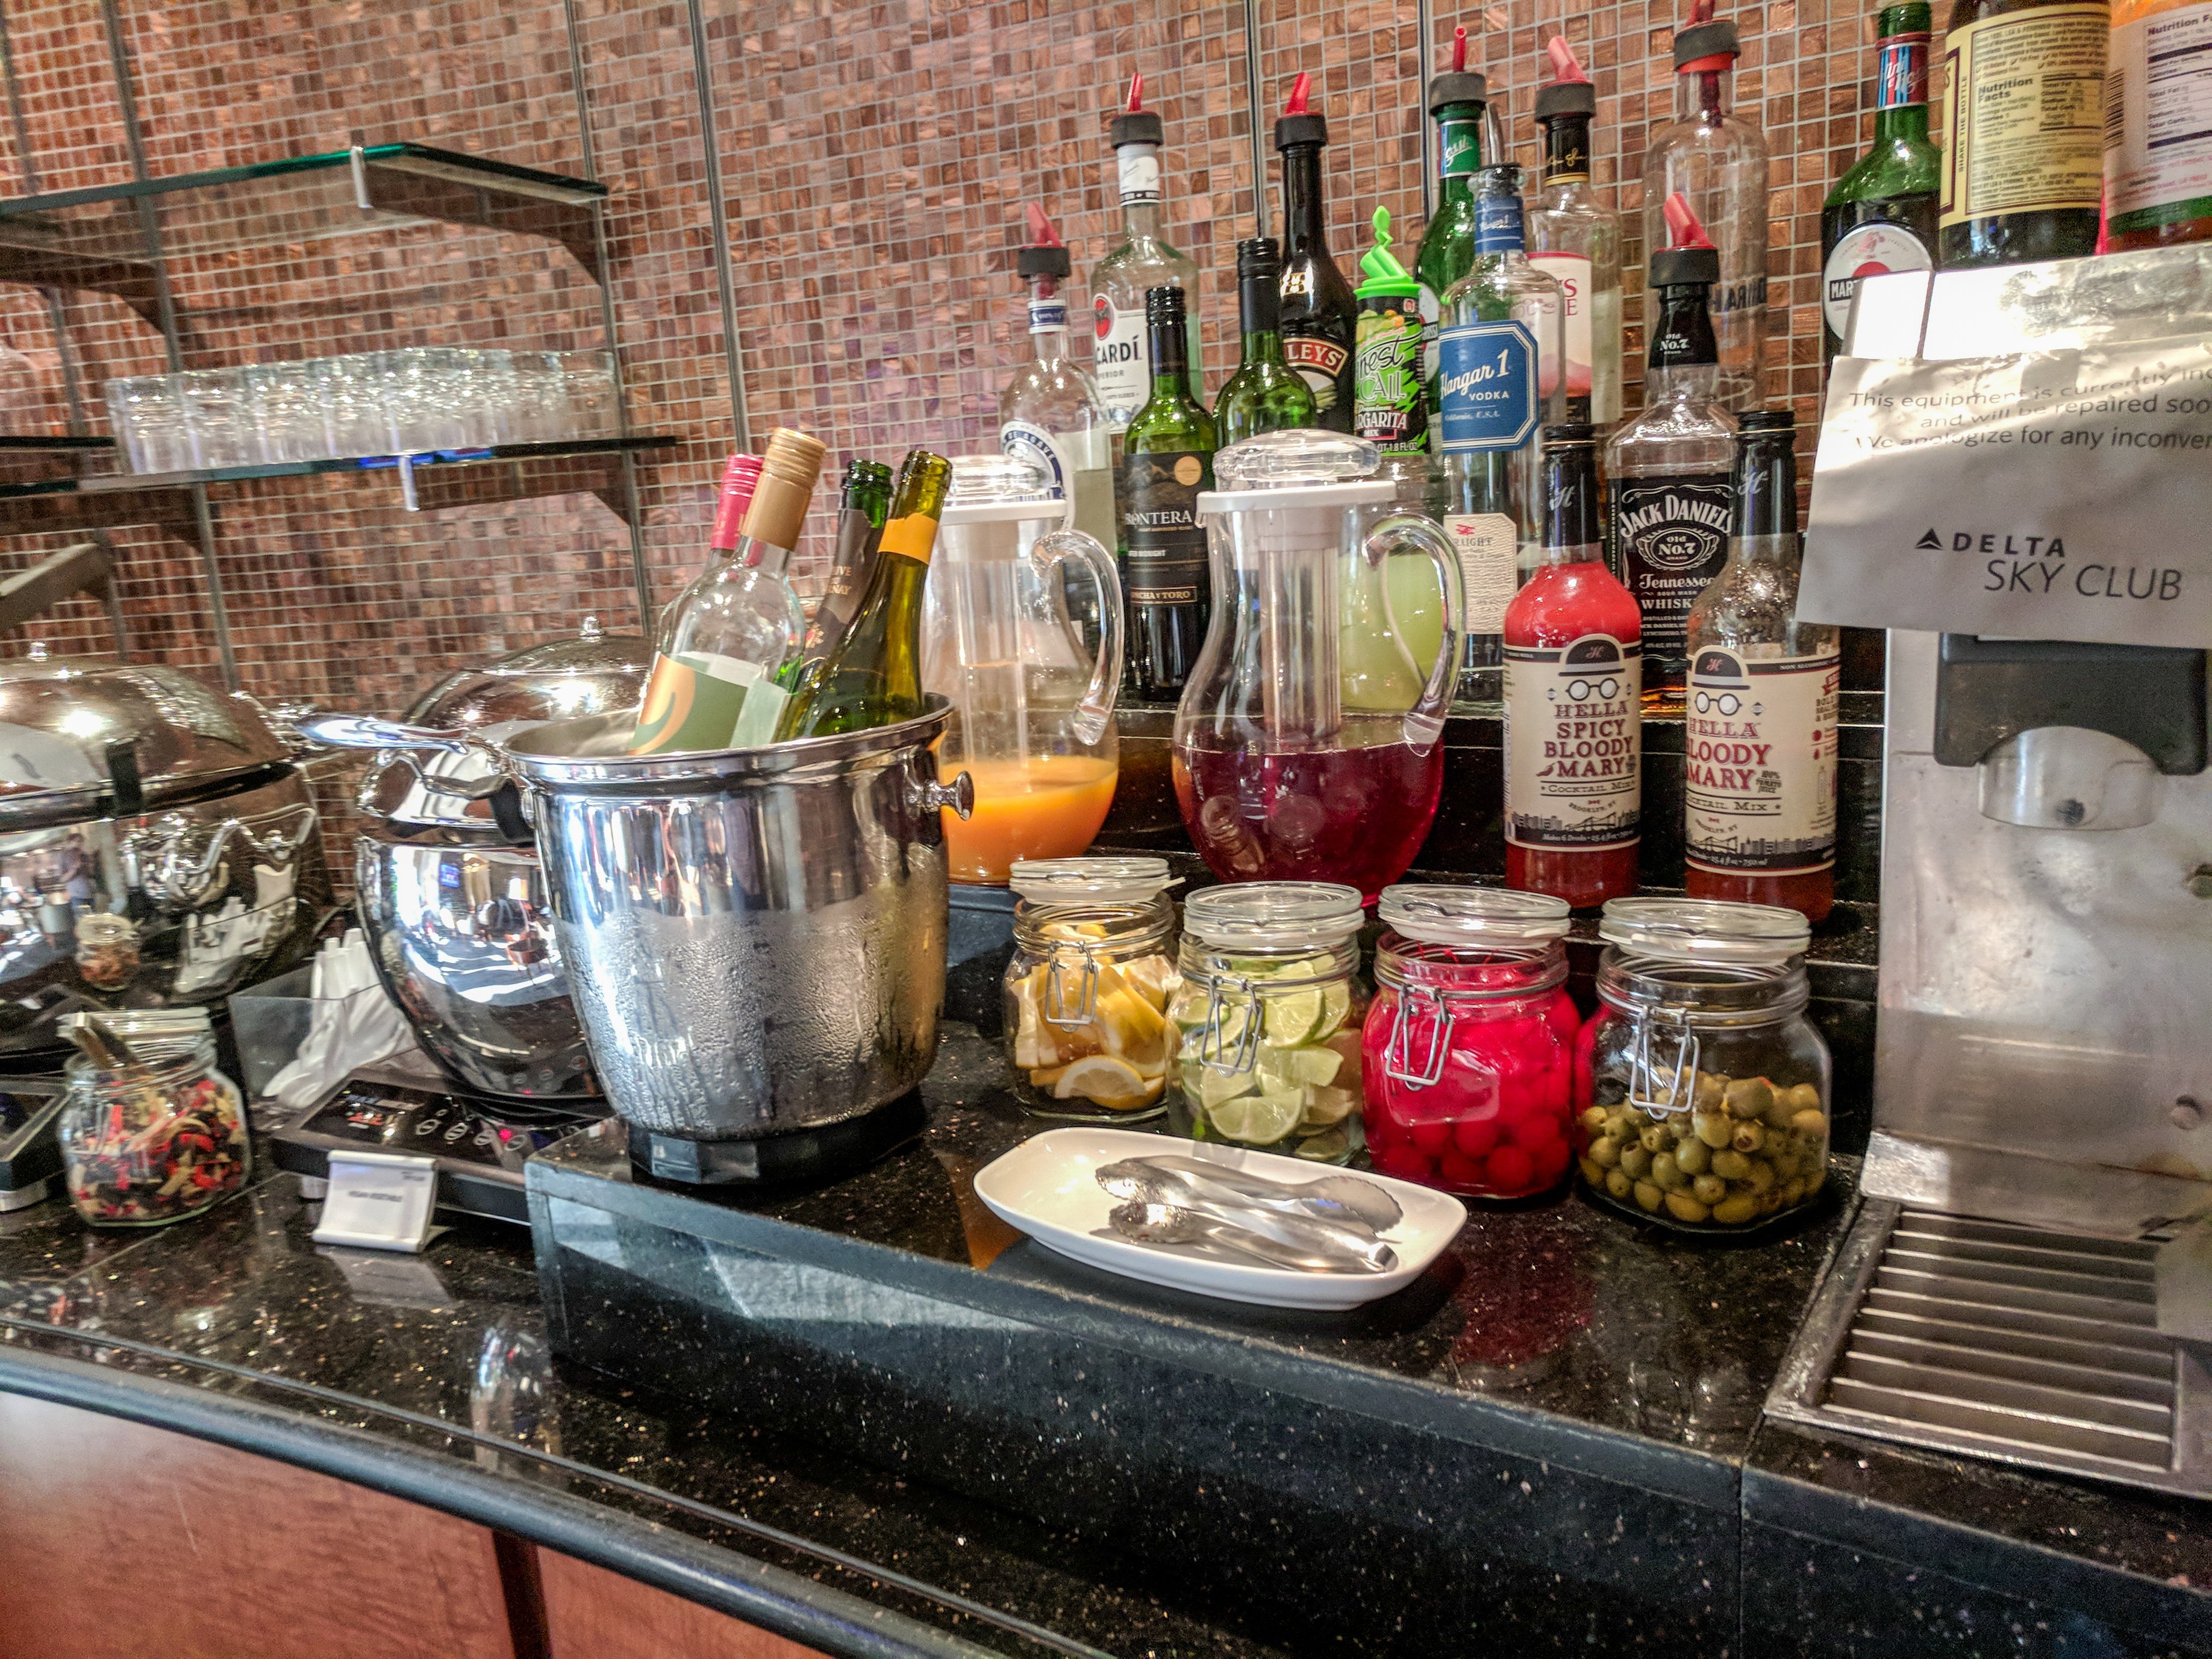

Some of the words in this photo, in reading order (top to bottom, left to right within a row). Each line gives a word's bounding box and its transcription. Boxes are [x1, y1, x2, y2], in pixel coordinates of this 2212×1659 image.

[2148, 18, 2199, 36] Nutrition
[2202, 14, 2212, 22] F
[1978, 77, 2033, 96] Nutrition
[1978, 90, 2011, 104] Facts
[1440, 364, 1495, 400] Hangar
[1496, 349, 1510, 378] 1
[1360, 370, 1407, 402] CALL
[1469, 390, 1510, 401] VODKA
[1849, 393, 1894, 407] This
[1901, 389, 2025, 409] equipment
[2034, 387, 2052, 400] is
[2060, 373, 2172, 396] currently
[1920, 414, 1963, 428] and
[1971, 408, 2011, 423] will
[2055, 393, 2159, 417] repaired
[2164, 398, 2212, 414] soo
[2021, 425, 2055, 445] for
[2060, 428, 2106, 451] any
[1618, 501, 1665, 538] JACK
[1658, 543, 1697, 555] No.7
[1952, 532, 2066, 558] DELTA
[1984, 559, 2066, 593] SKY
[2075, 563, 2184, 601] CLUB
[1640, 598, 1695, 610] WHISK
[1554, 701, 1628, 719] HELLA
[1557, 719, 1626, 739] SPICY
[1688, 717, 1762, 739] HELLA
[1543, 736, 1634, 758] BLOODY
[1687, 736, 1772, 766] LOODY
[1557, 756, 1625, 778] MARY
[1687, 761, 1755, 790] MARY
